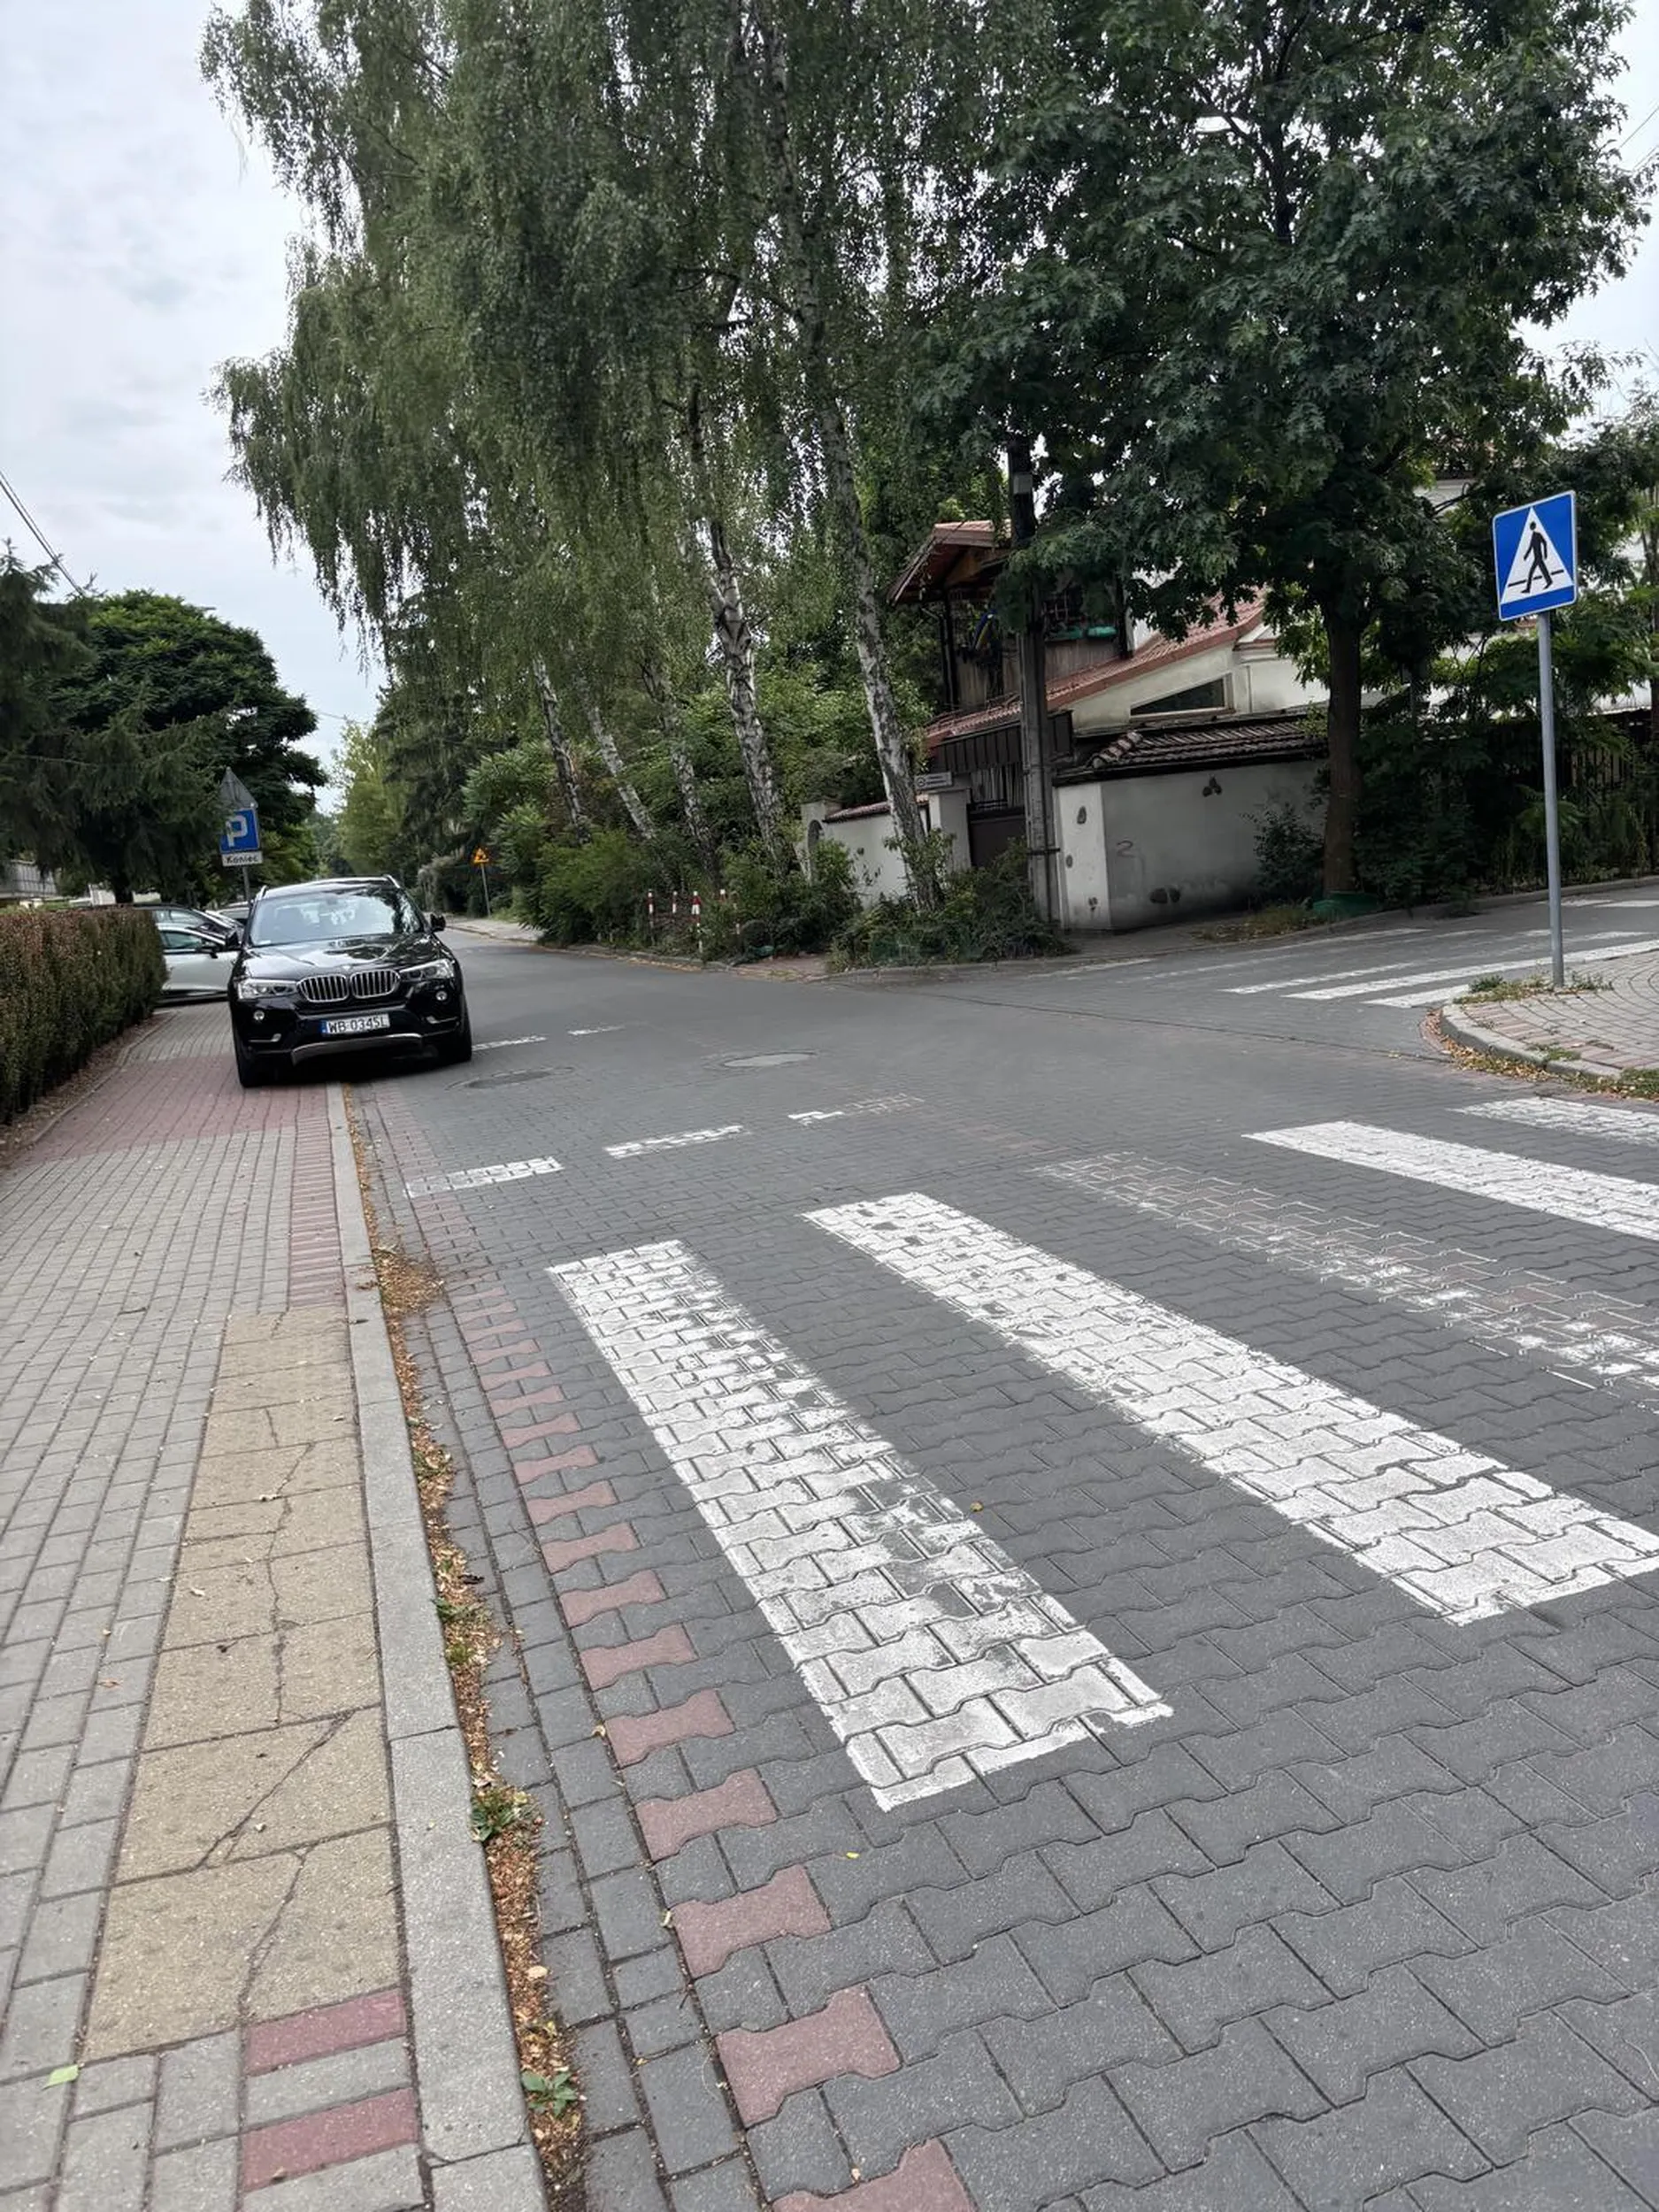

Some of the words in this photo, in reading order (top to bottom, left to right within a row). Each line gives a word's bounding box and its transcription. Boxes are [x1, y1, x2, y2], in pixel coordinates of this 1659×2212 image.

[226, 815, 248, 847] P
[226, 854, 258, 864] Koniec
[328, 1020, 346, 1033] WB
